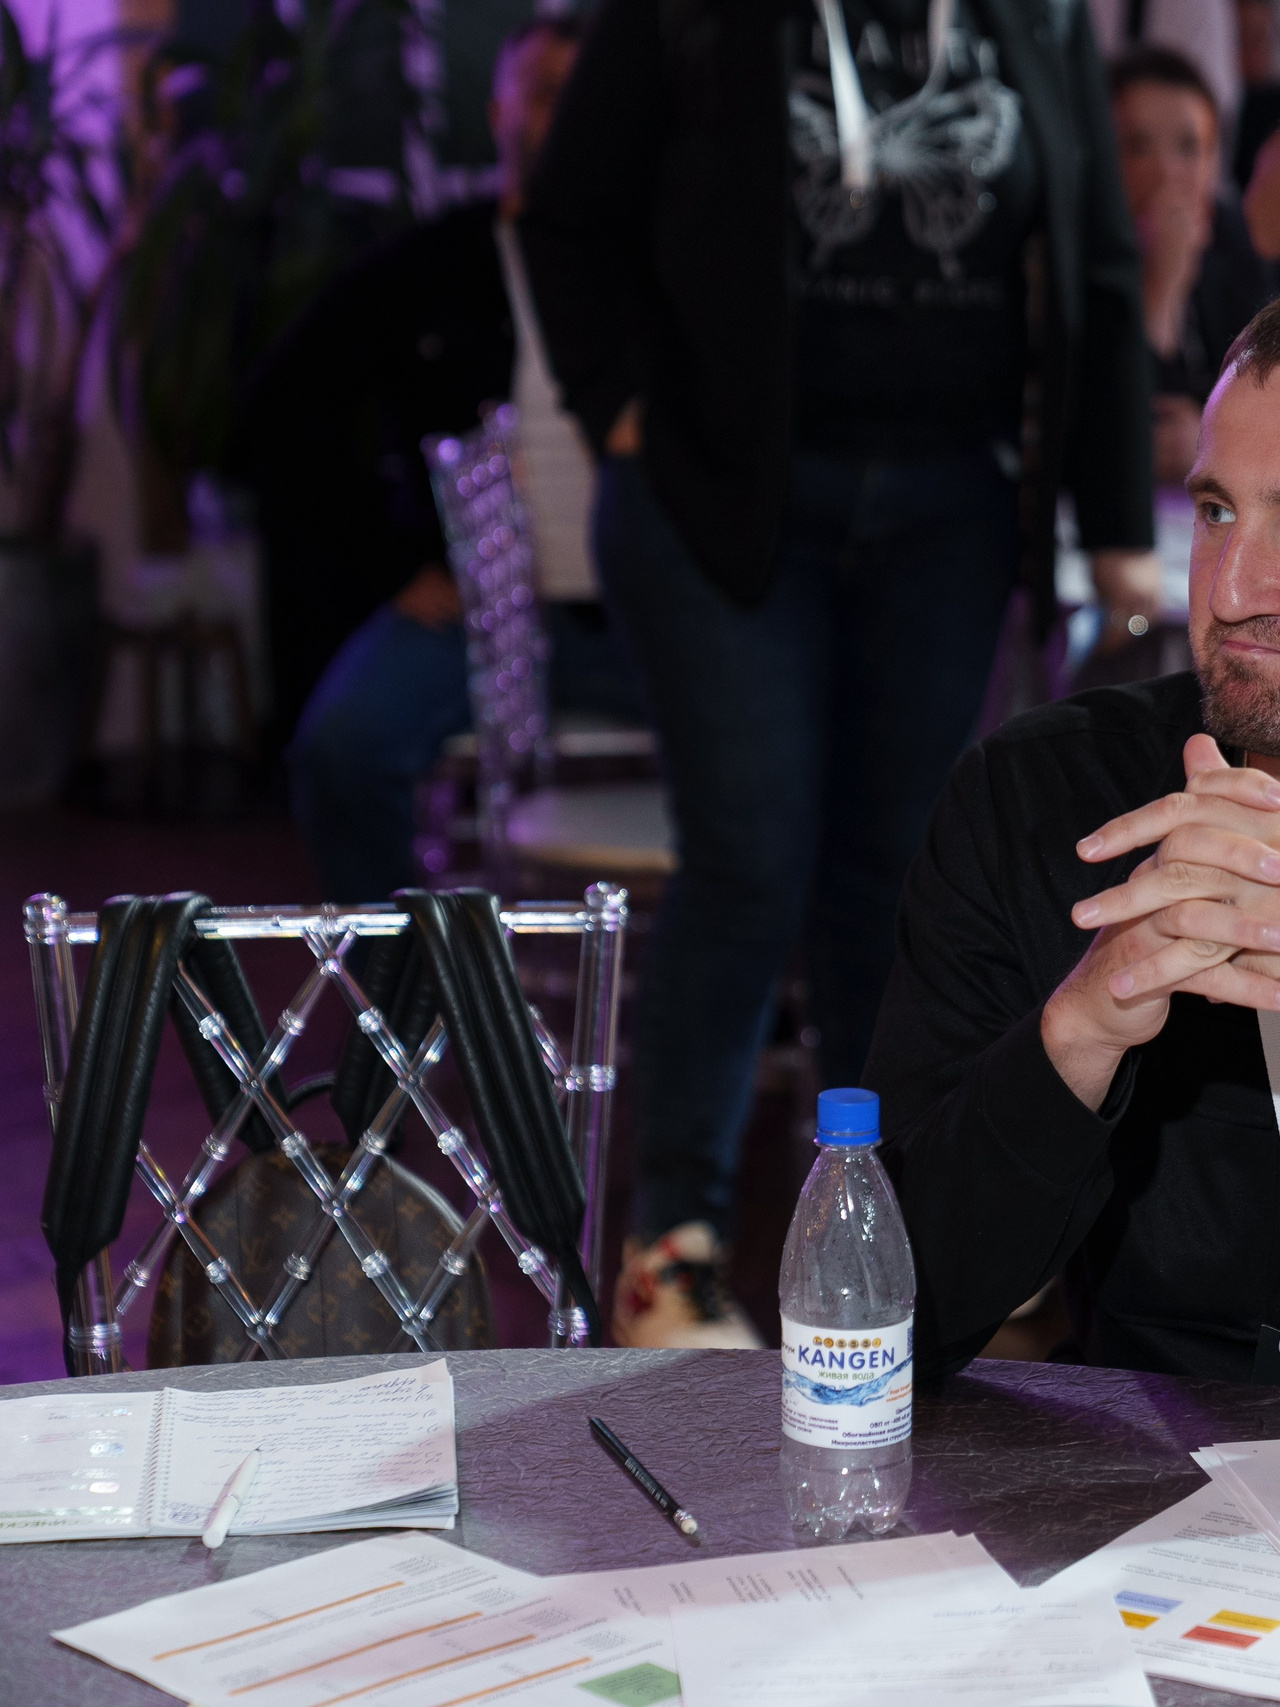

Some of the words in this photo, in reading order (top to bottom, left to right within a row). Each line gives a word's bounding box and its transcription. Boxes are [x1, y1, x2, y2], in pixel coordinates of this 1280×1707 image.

[798, 1344, 895, 1371] KANGEN
[818, 1370, 849, 1380] живая
[852, 1371, 875, 1381] вода
